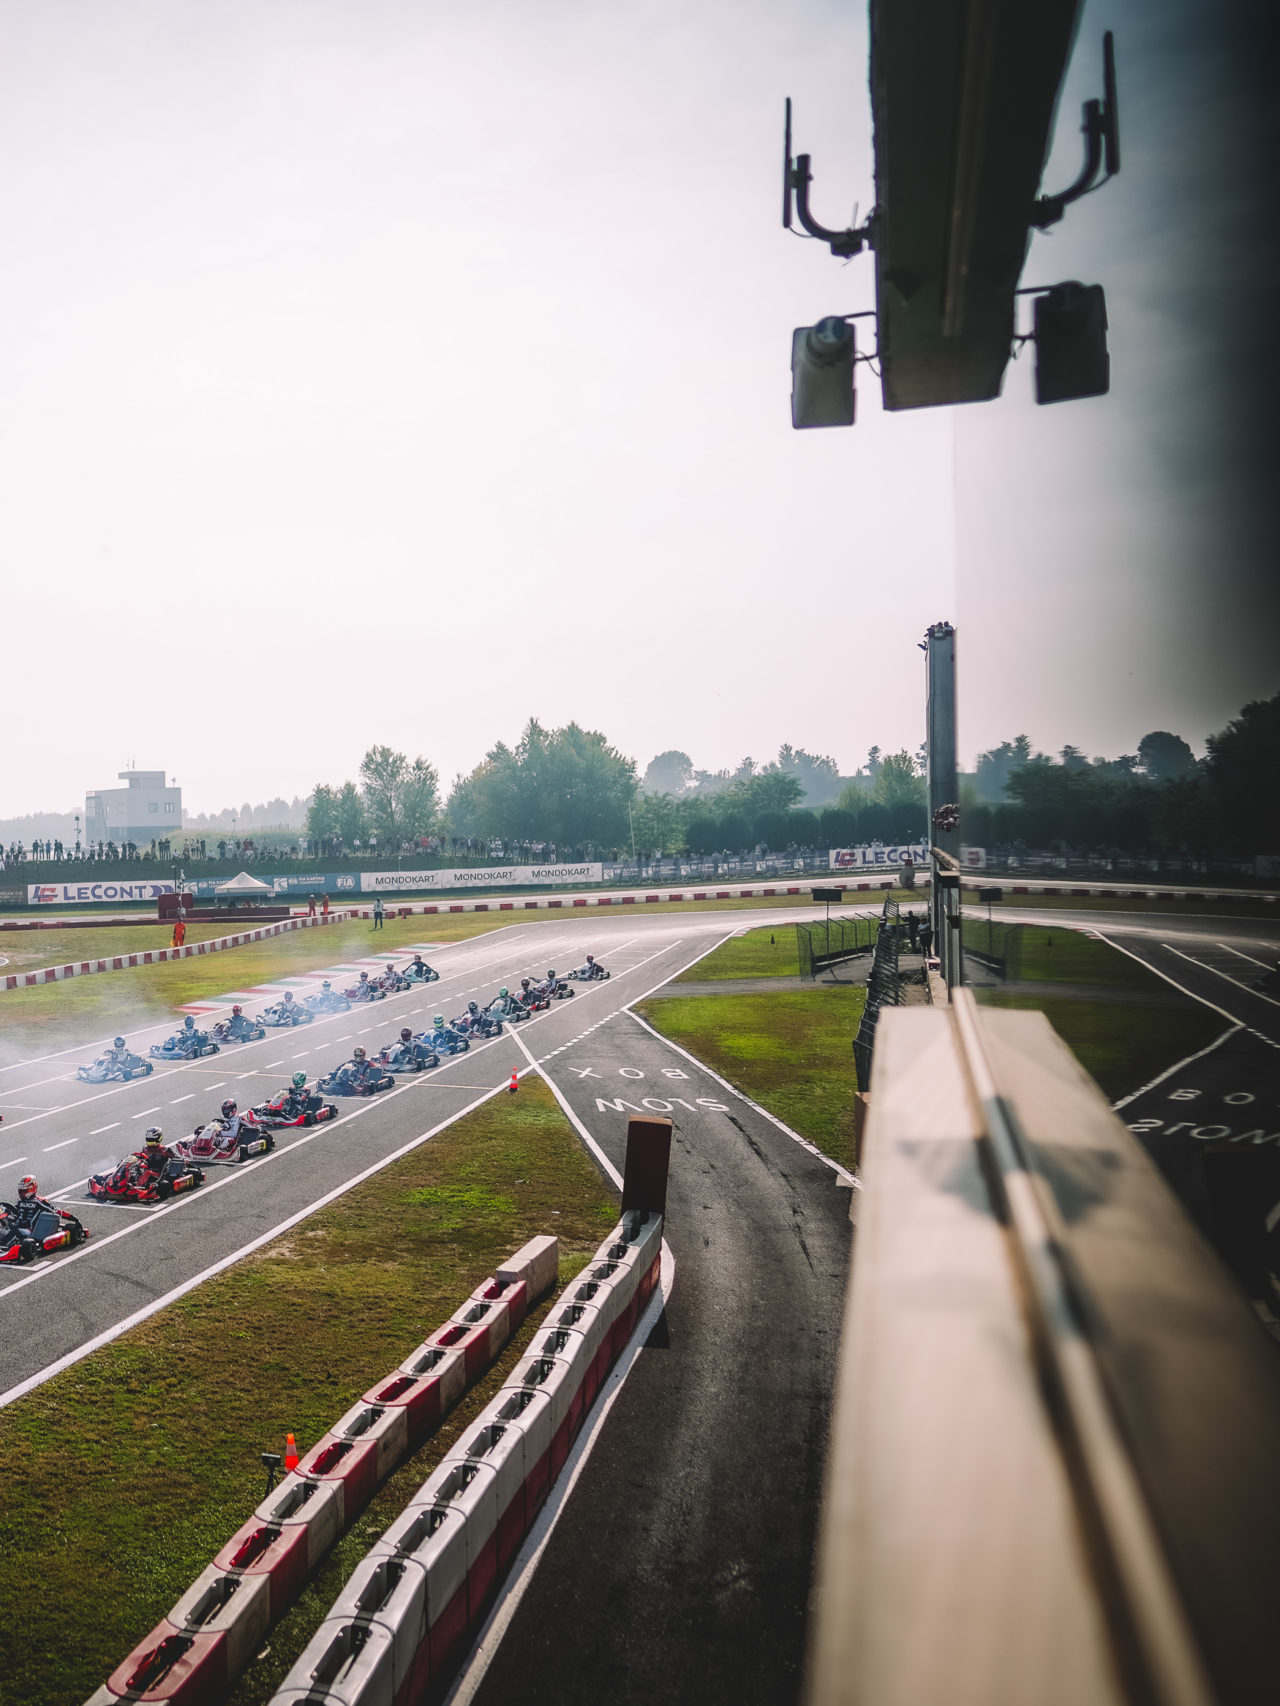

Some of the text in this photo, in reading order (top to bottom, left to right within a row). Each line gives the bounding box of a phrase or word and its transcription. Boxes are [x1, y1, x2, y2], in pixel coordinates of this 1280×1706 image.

[862, 848, 930, 865] LECON
[454, 871, 513, 881] MONDOKART
[532, 867, 590, 878] MONDOKART
[337, 877, 354, 888] FIA
[375, 875, 435, 885] MONDOKART
[568, 1067, 690, 1079] BOX
[594, 1098, 730, 1112] SLOW
